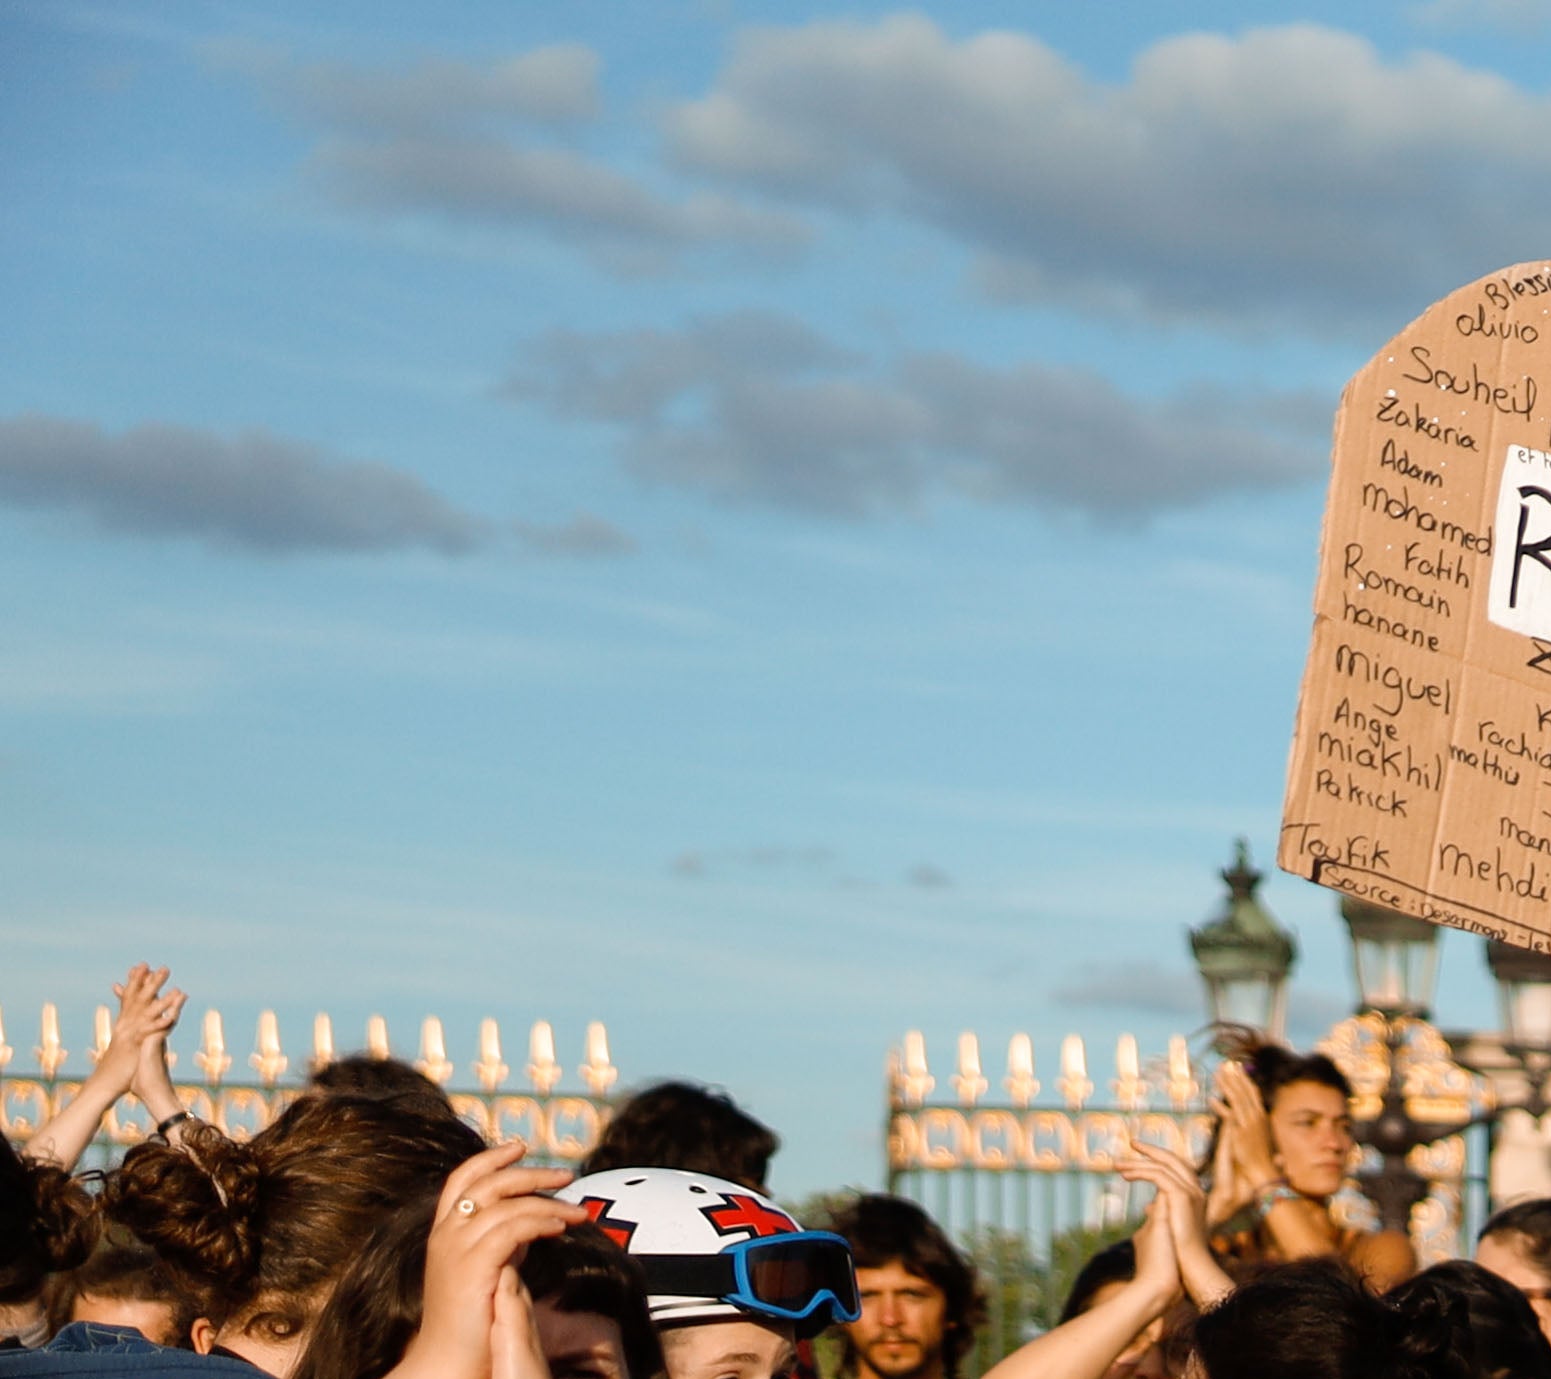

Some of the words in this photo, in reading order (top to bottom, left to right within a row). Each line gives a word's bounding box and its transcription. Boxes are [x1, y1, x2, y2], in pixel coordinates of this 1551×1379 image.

[1518, 449, 1535, 463] et
[1345, 543, 1451, 618] Romain
[1334, 697, 1399, 748] Ange
